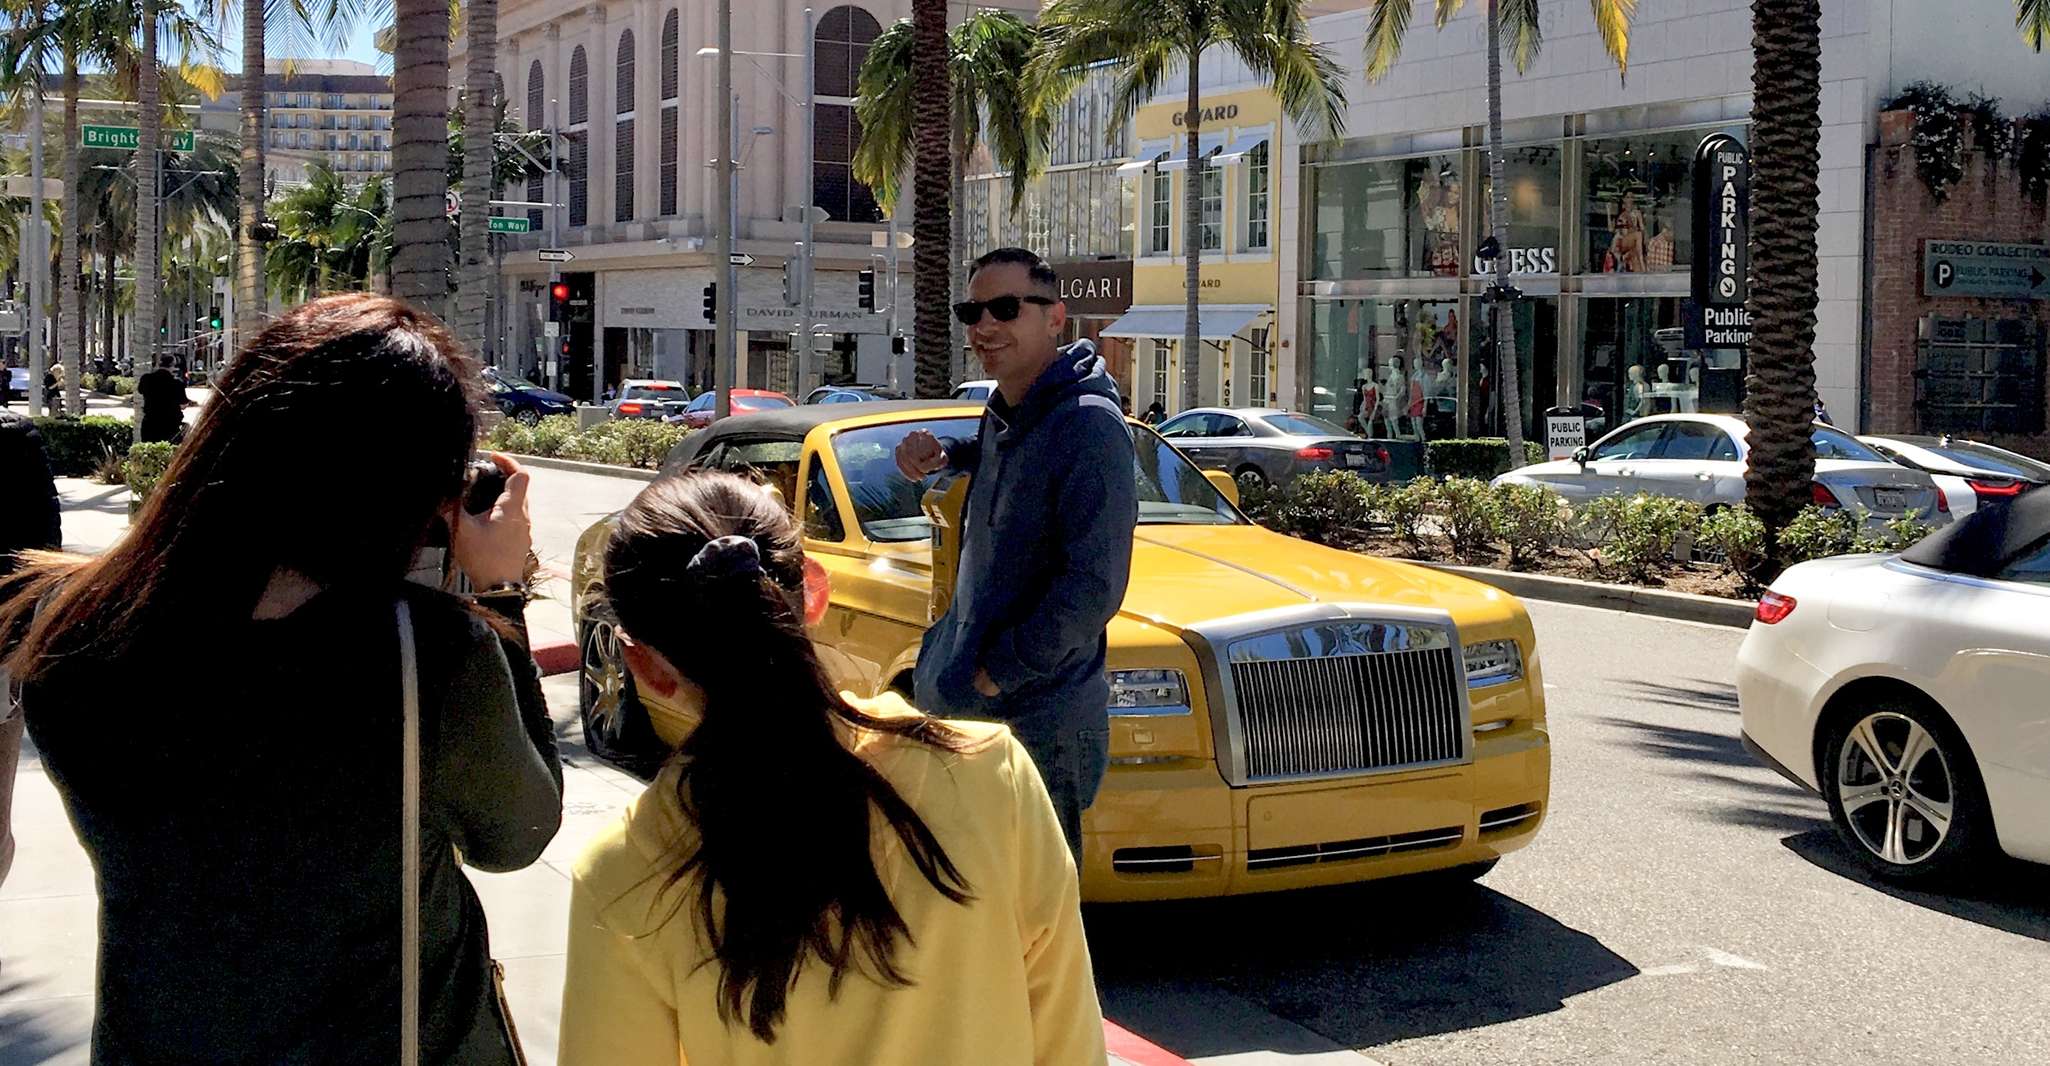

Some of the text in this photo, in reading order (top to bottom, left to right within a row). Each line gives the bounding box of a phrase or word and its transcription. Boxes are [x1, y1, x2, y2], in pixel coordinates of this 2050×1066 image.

[1172, 104, 1238, 126] GARD
[88, 131, 140, 146] Bright
[1717, 152, 1744, 164] PUBLIC
[508, 221, 526, 231] Way
[1720, 166, 1737, 275] PARKING
[1930, 243, 1974, 255] RODEO
[1474, 247, 1555, 274] GESS
[1060, 277, 1122, 298] LGARI
[746, 308, 862, 319] DAVID URMAN
[1551, 422, 1581, 433] PUBLIC
[1550, 436, 1584, 447] PARKING
